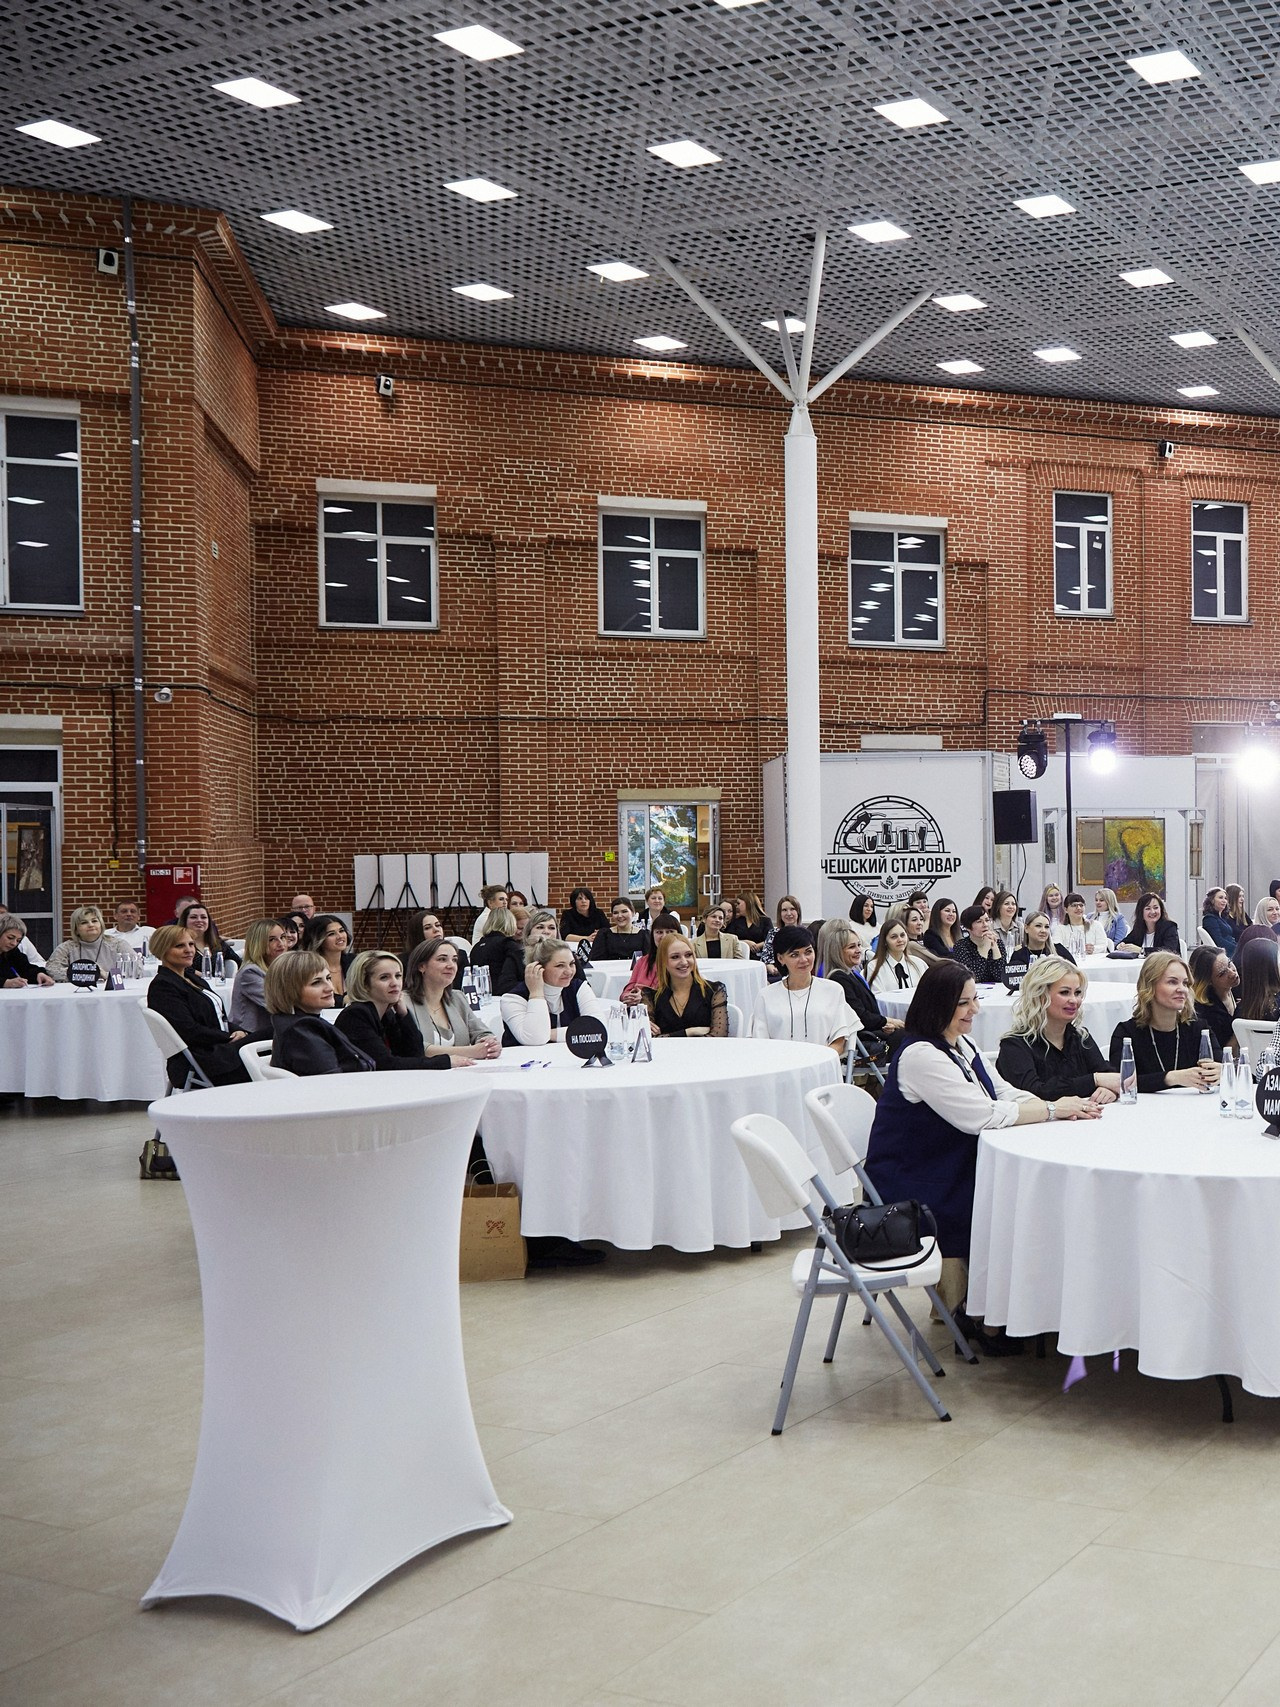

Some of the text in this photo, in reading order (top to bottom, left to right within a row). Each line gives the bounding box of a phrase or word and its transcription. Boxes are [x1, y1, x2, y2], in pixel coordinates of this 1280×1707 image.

[820, 855, 962, 874] ЧЕШСКИЙ СТАРОВАР
[866, 889, 894, 900] пивных
[112, 973, 123, 985] 16
[465, 992, 478, 1005] 15
[571, 1033, 603, 1044] НА ПОСОШОК
